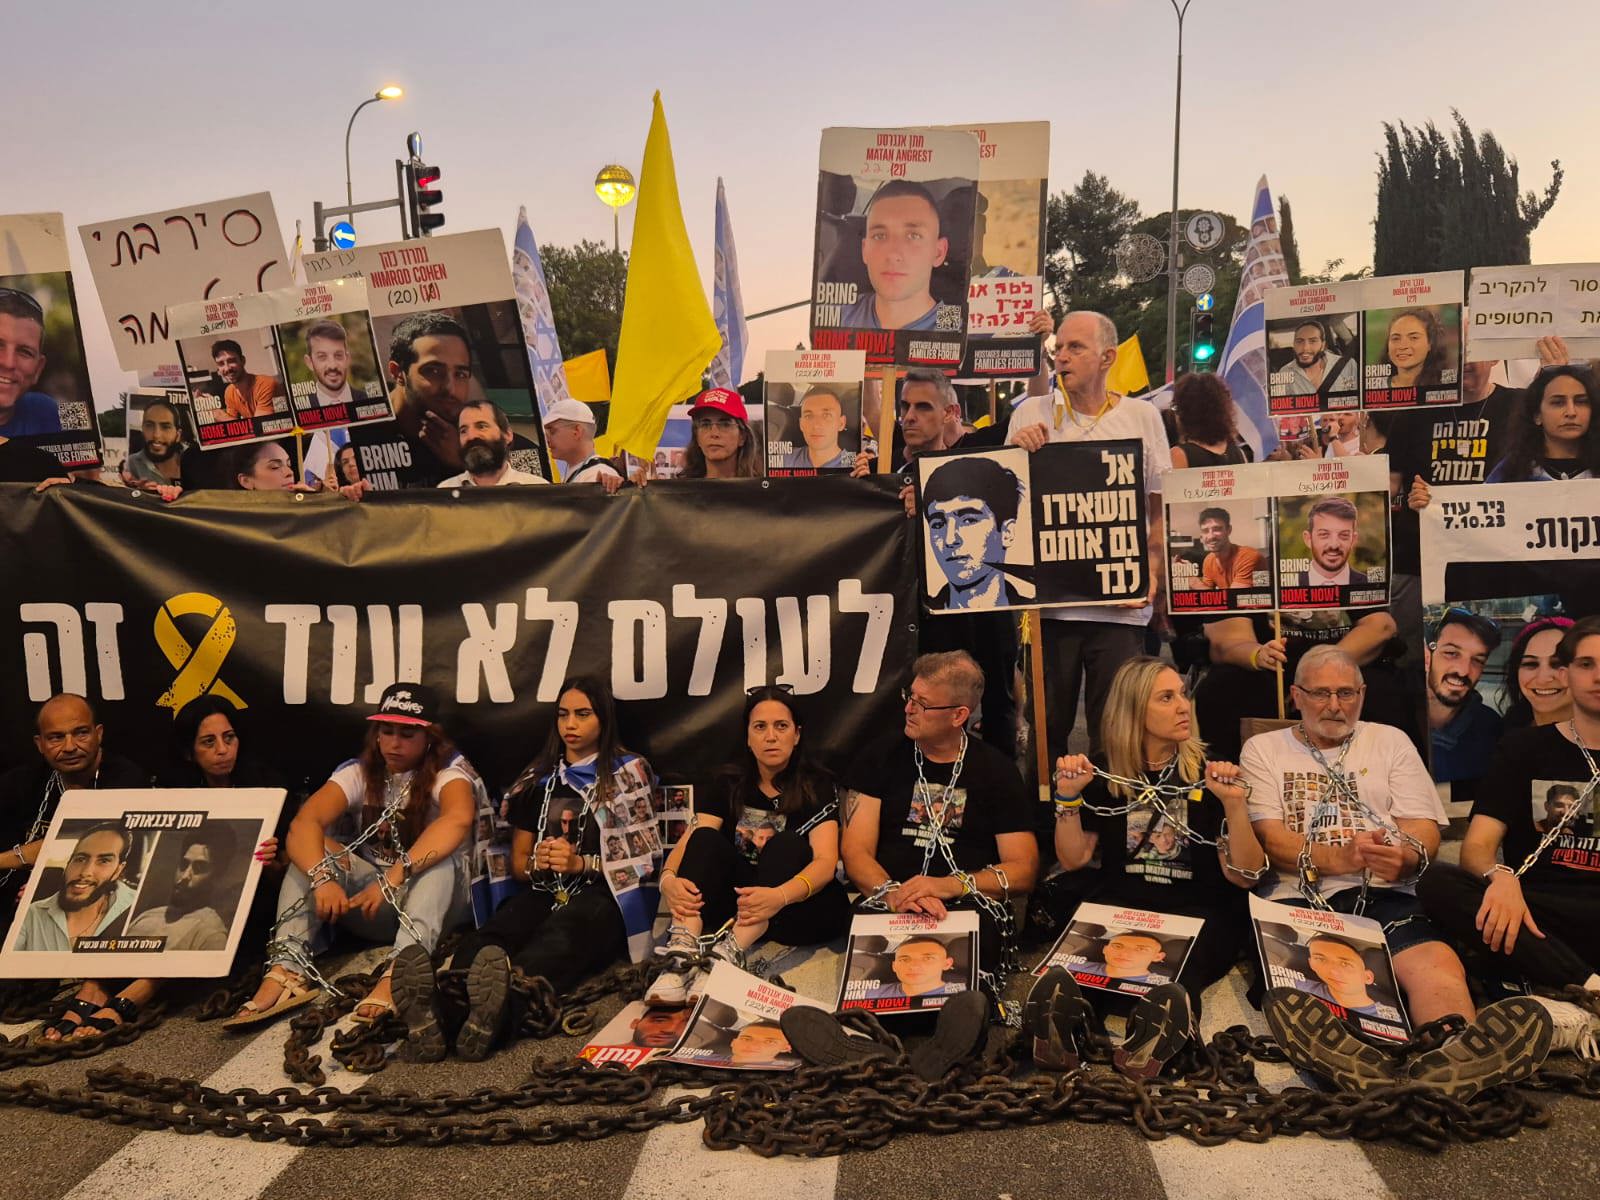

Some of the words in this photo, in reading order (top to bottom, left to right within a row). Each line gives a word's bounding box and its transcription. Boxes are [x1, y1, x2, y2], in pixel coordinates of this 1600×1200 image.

[866, 148, 894, 161] MATAN
[895, 150, 933, 163] ANGREST
[890, 162, 906, 177] (21)
[92, 209, 262, 267] סירבתי
[378, 250, 398, 270] כהן
[398, 246, 429, 266] נמרוד
[370, 268, 411, 289] NIMROD
[412, 263, 448, 283] COHEN
[816, 282, 858, 305] BRING
[1479, 276, 1547, 298] להקריב
[388, 287, 418, 308] (20)
[815, 304, 841, 327] HIM
[1475, 311, 1553, 326] החטופים
[813, 329, 850, 350] HOME
[856, 330, 895, 355] NOW!
[909, 349, 937, 360] FAMILIES
[938, 350, 960, 361] FORUM
[974, 358, 1007, 369] FAMILIES
[1008, 357, 1034, 369] FORUM
[1270, 372, 1295, 385] BRING
[1365, 364, 1392, 378] BRING
[291, 380, 317, 397] BRING
[1270, 384, 1287, 397] HIM
[1366, 390, 1390, 403] HOME
[1392, 387, 1417, 401] NOW!
[193, 396, 222, 412] BRING
[294, 395, 312, 411] HIM
[1271, 396, 1294, 410] HOME
[1295, 393, 1320, 409] NOW!
[196, 411, 215, 426] HIM
[298, 409, 321, 426] HOME
[322, 403, 349, 421] NOW!
[200, 424, 225, 440] HOME
[226, 418, 255, 436] NOW!
[1432, 421, 1454, 439] הם
[1457, 418, 1490, 438] למה
[768, 441, 793, 455] BRING
[1431, 438, 1488, 460] עדיין
[360, 441, 412, 472] BRING
[768, 454, 784, 468] HIM
[1101, 450, 1136, 486] אל
[1431, 460, 1486, 482] בעזה?
[1312, 473, 1330, 482] DAVID
[1331, 471, 1349, 480] CUNIO
[1041, 489, 1138, 526] תשאירו
[1441, 501, 1471, 517] עוז
[1477, 500, 1505, 514] ניר
[1443, 515, 1506, 529] 7.10.23
[1039, 527, 1104, 562] אותם
[1109, 526, 1141, 558] גם
[1172, 562, 1199, 577] BRING
[1280, 558, 1310, 573] BRING
[1096, 558, 1141, 595] לבד
[1280, 572, 1300, 587] HIM
[1173, 592, 1199, 606] HOME
[1200, 590, 1228, 606] NOW!
[1281, 588, 1308, 603] HOME
[1310, 586, 1340, 602] NOW!
[456, 587, 579, 704] לא
[608, 578, 894, 701] לעולם
[19, 602, 125, 703] זה
[264, 603, 424, 705] עוד
[125, 814, 177, 829] צנגאוקר
[177, 814, 203, 829] מתן
[1051, 952, 1087, 965] BRING
[1074, 971, 1111, 985] NOW!
[1269, 964, 1306, 982] BRING
[846, 979, 881, 990] BRING
[747, 989, 770, 1003] MATAN
[844, 989, 867, 1000] HIM
[842, 998, 874, 1010] HOME
[877, 997, 911, 1009] NOW!
